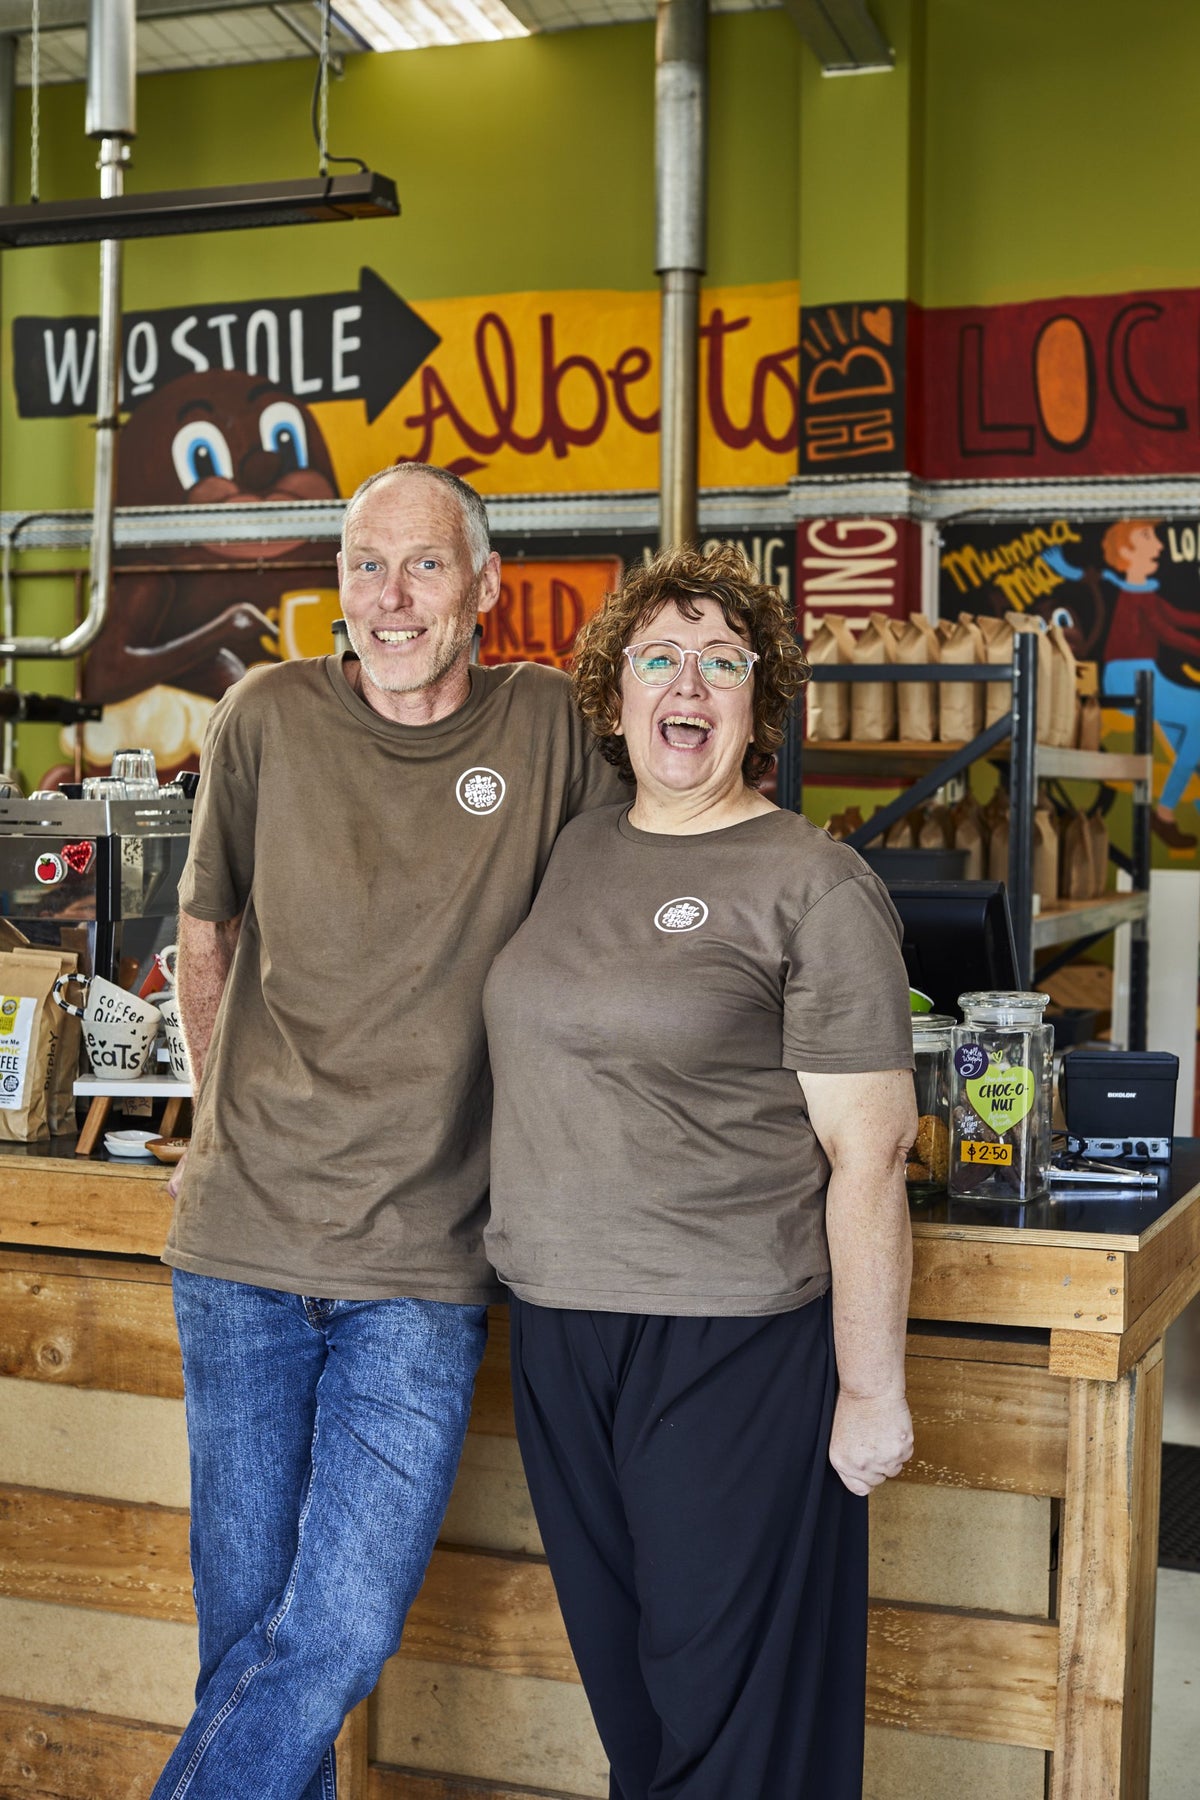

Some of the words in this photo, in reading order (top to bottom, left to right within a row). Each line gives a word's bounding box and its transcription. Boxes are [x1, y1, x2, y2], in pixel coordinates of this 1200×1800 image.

[44, 319, 158, 406] WO
[172, 306, 362, 394] STOLE
[396, 308, 799, 476] Albeto
[1168, 526, 1200, 563] LO
[0, 1055, 20, 1071] FEE
[991, 1098, 1016, 1112] NUT
